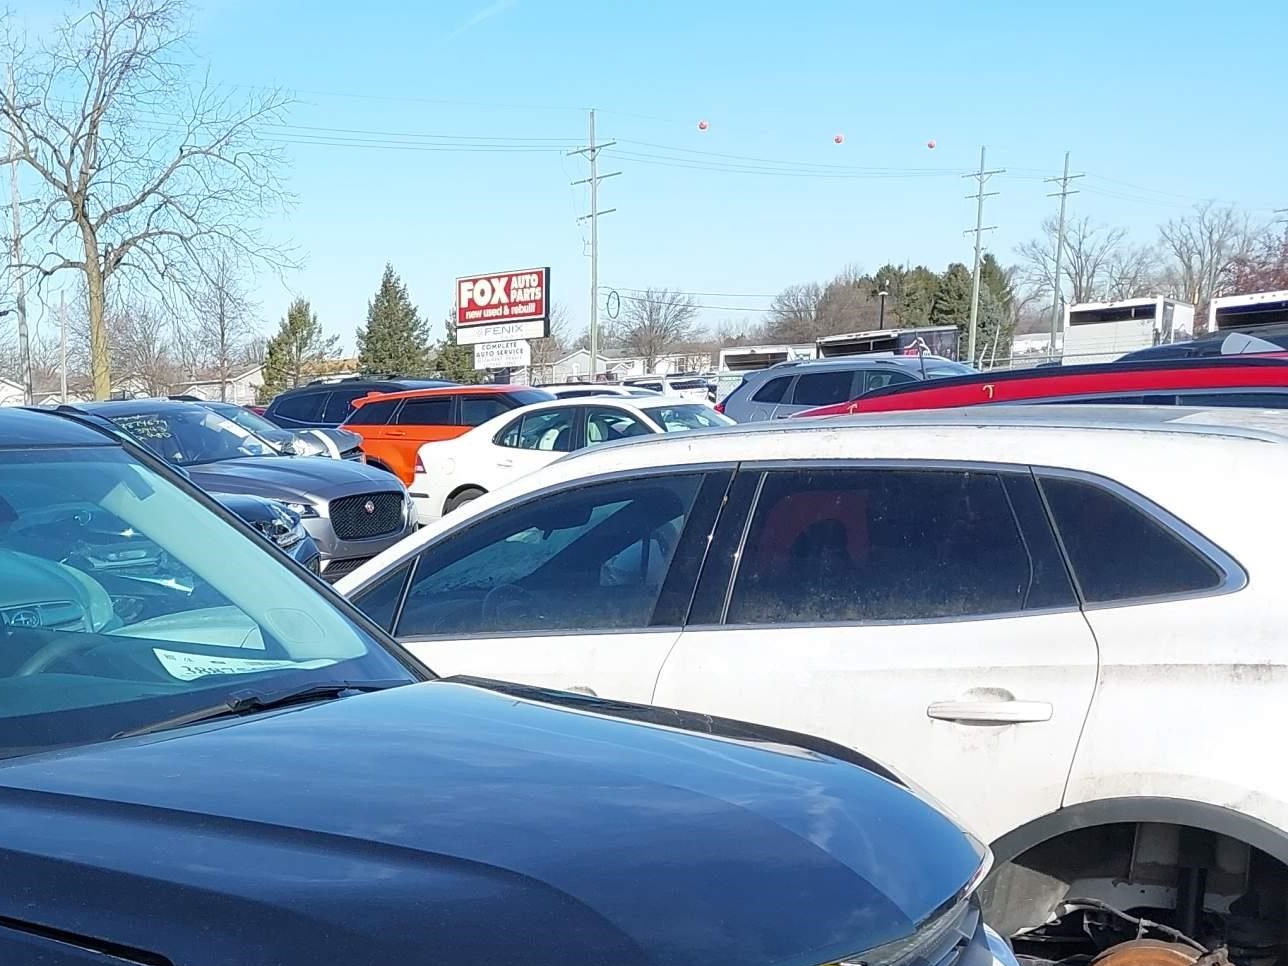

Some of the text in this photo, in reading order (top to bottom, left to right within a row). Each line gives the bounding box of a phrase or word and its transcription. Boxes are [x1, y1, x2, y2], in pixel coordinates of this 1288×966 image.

[511, 273, 539, 288] AUTO
[460, 277, 509, 308] FOX
[511, 287, 542, 303] PARTS
[466, 309, 482, 320] new
[483, 306, 502, 318] used
[503, 305, 510, 315] &
[484, 324, 523, 336] FENIX
[476, 348, 524, 358] AUTO SERVICE
[481, 342, 517, 351] COMPLETE
